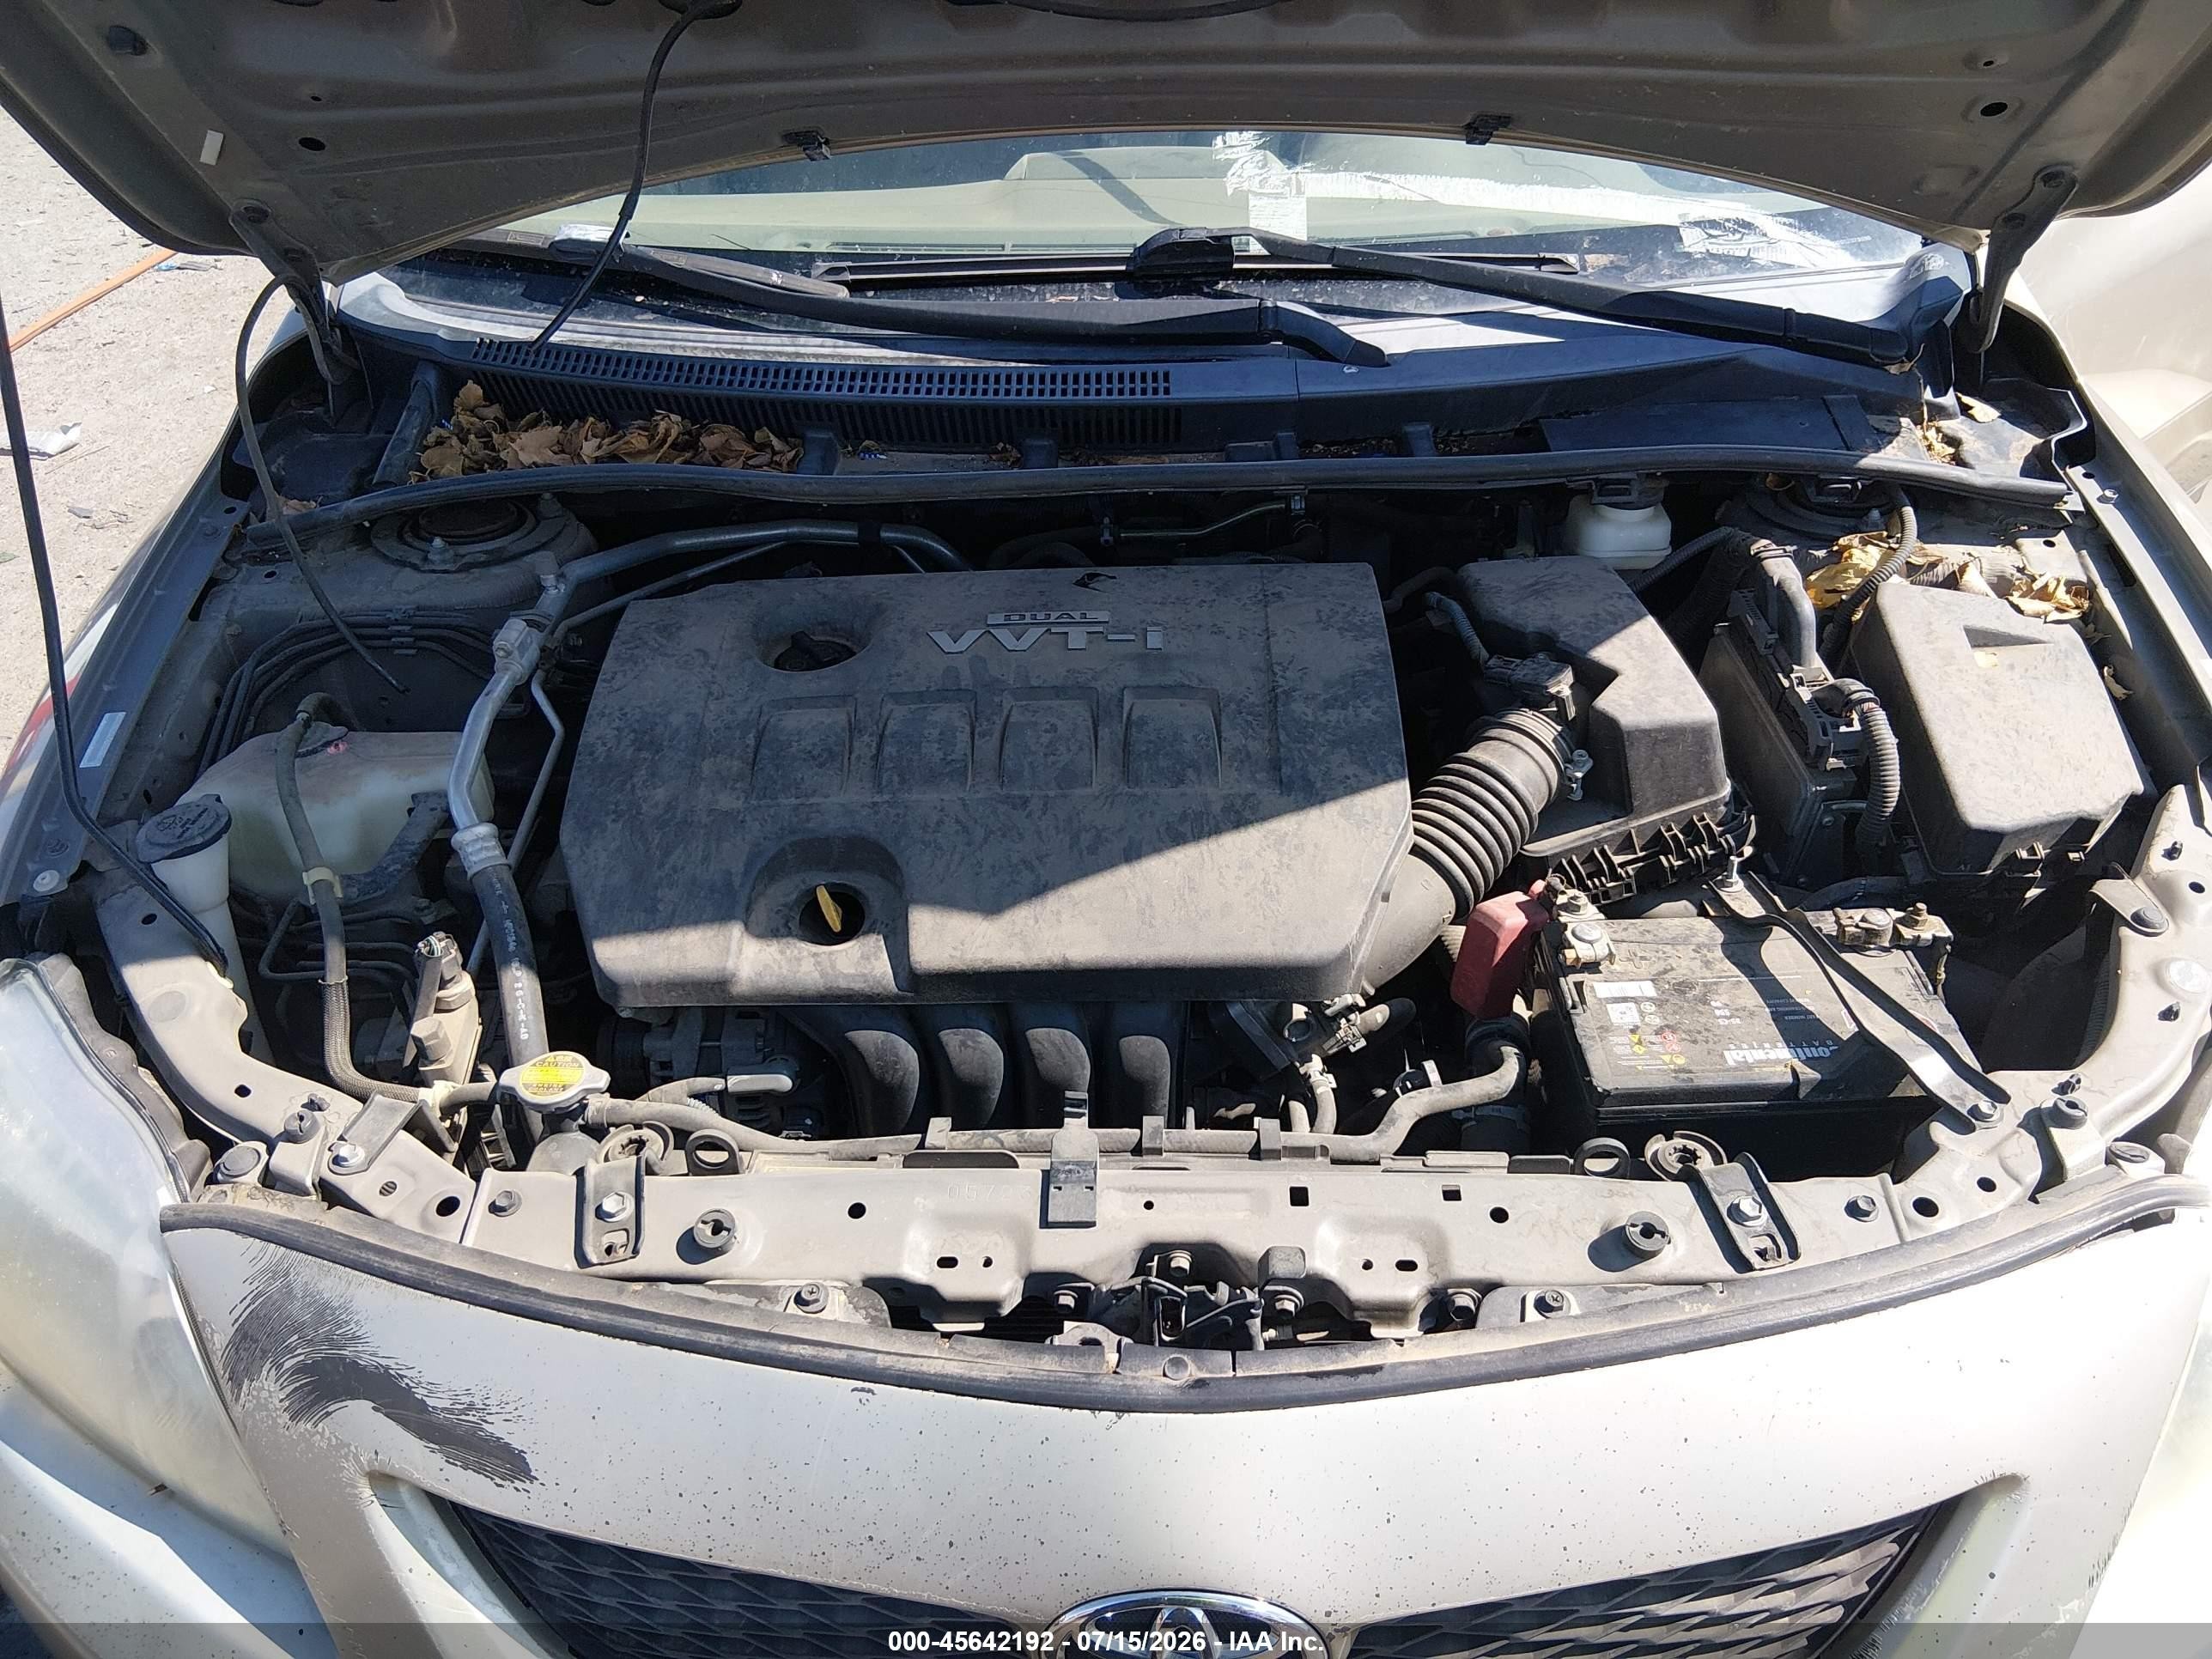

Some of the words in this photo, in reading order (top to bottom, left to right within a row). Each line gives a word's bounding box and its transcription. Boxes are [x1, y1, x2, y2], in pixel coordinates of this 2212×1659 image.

[1003, 611, 1099, 622] DUAL
[927, 626, 1164, 654] VVT-i
[1729, 1039, 1834, 1049] BATTERIES
